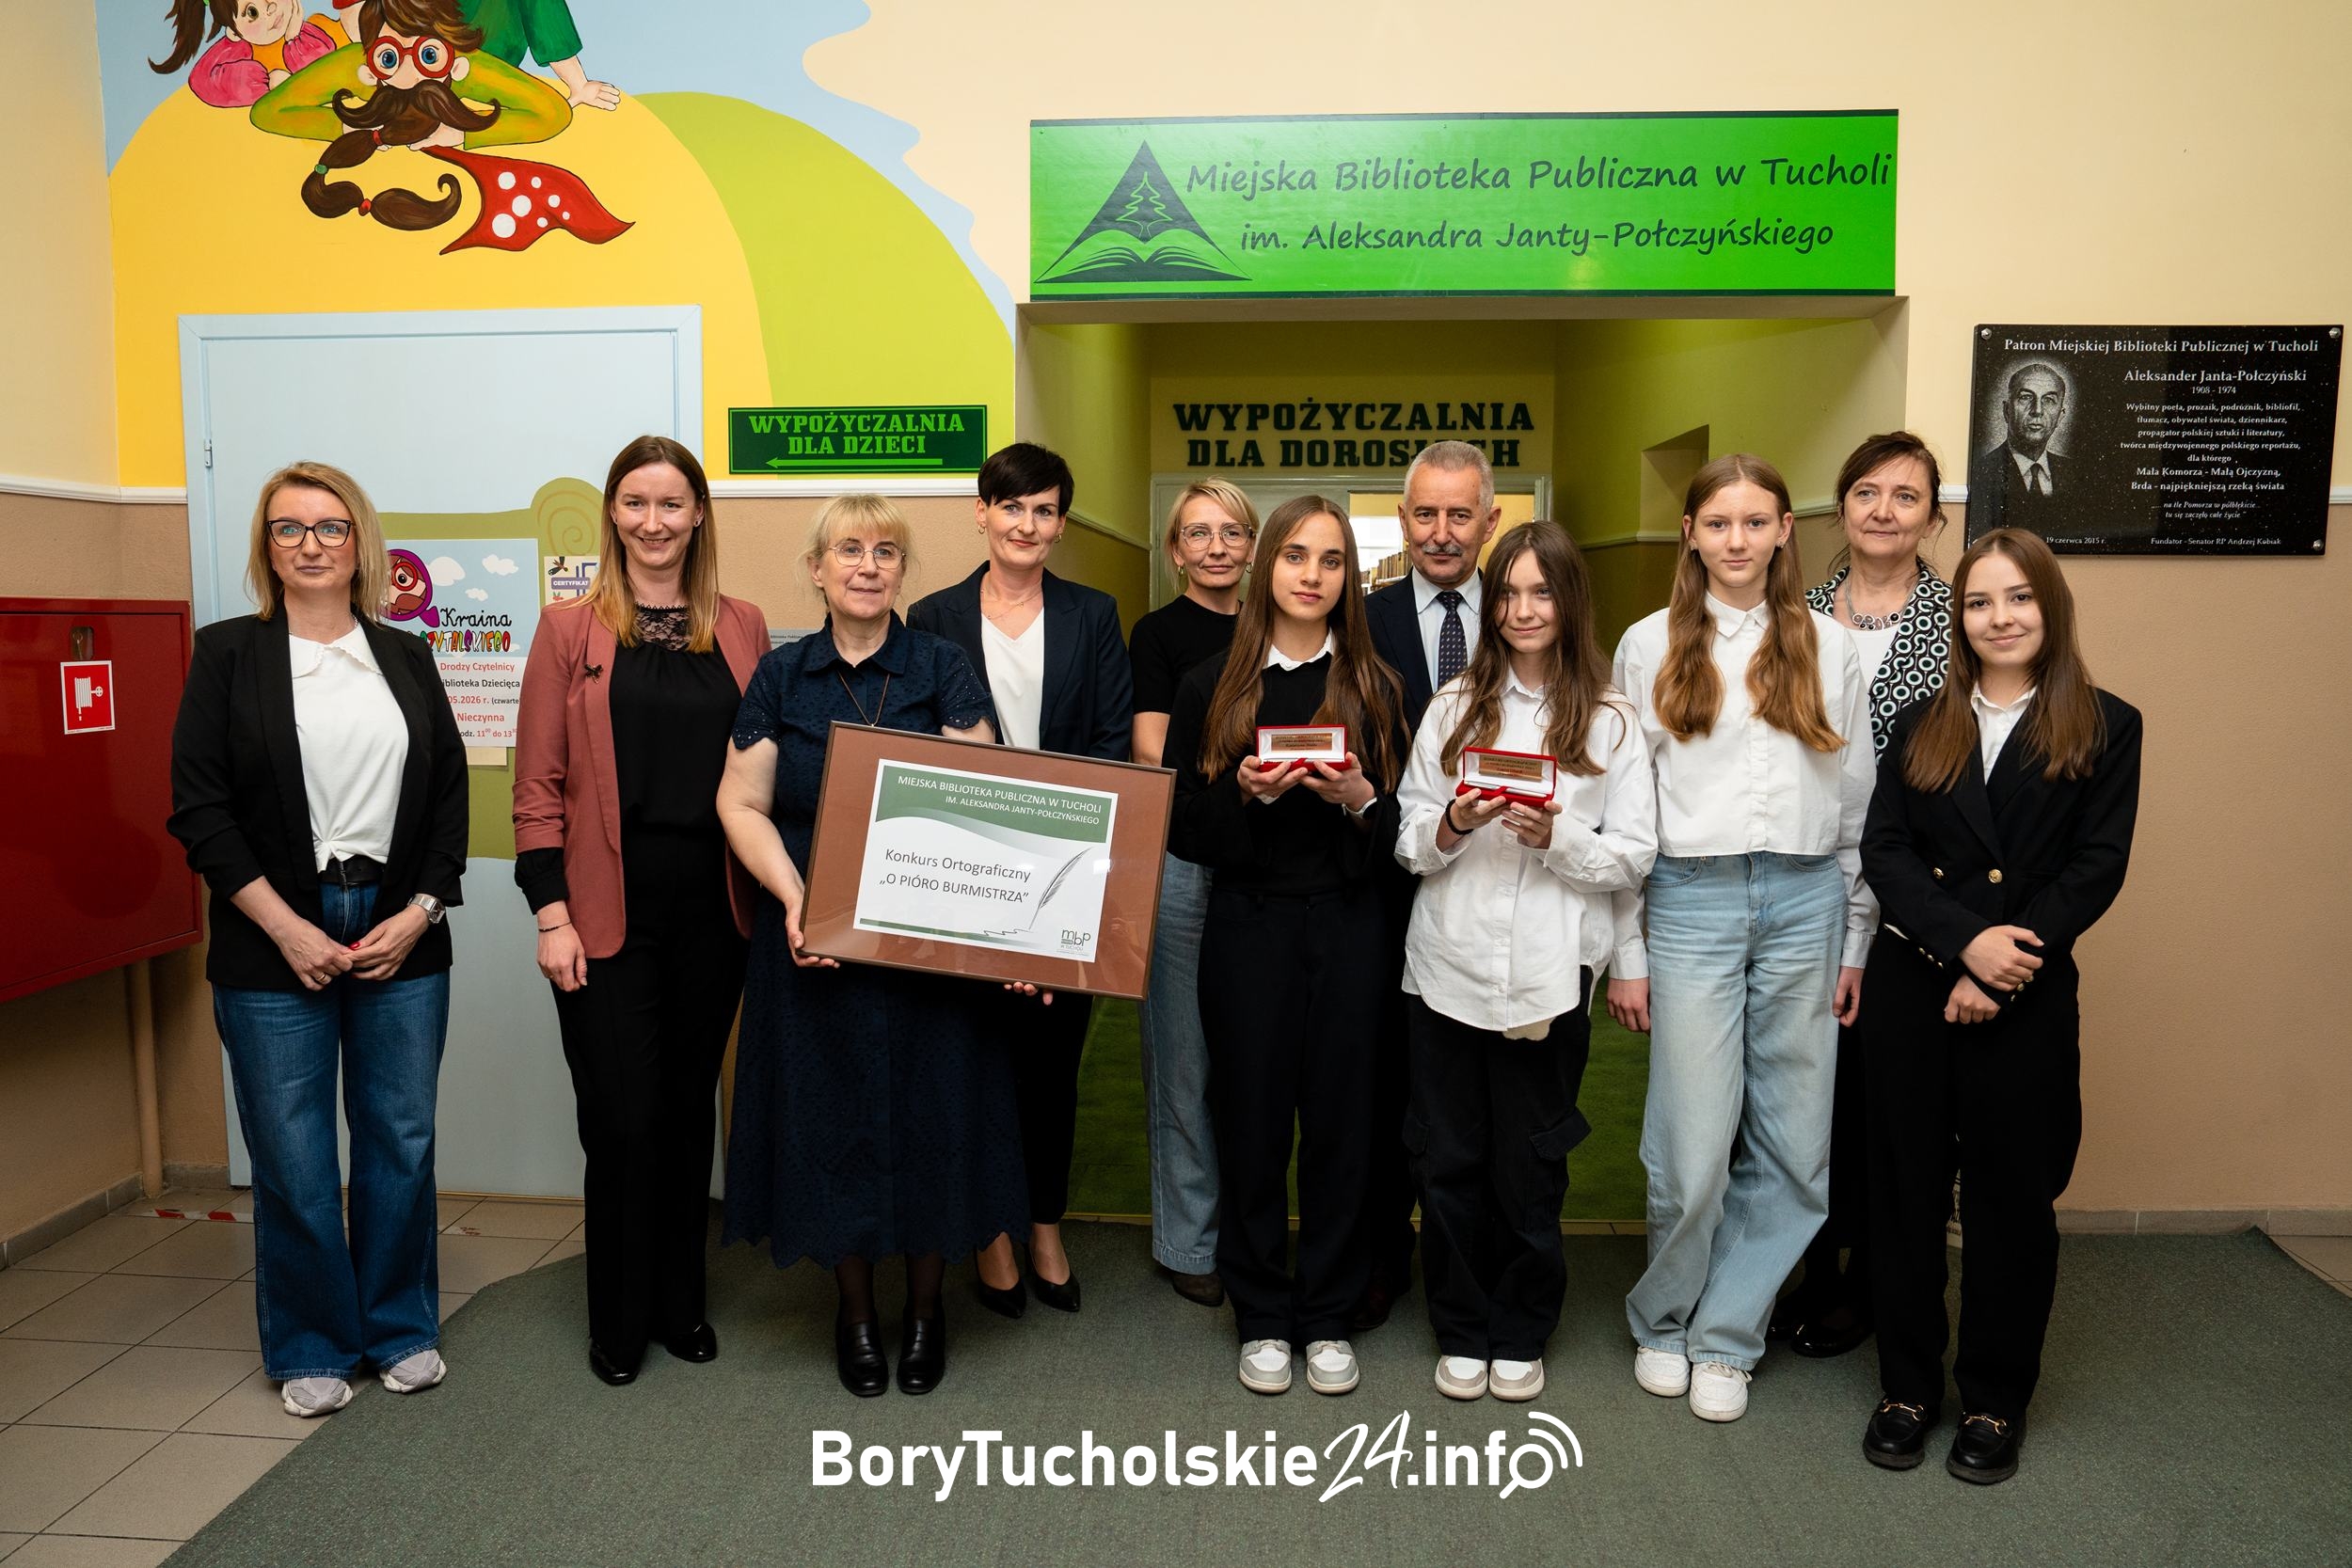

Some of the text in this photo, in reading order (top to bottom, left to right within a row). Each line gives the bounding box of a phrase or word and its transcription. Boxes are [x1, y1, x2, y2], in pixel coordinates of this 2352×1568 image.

[1186, 152, 1893, 201] Miejska Biblioteka Publiczna w Tucholi
[1241, 217, 1834, 257] im. Aleksandra Janty-Połczyńskiego
[2004, 339, 2318, 355] Patron Miejskiej Biblioteki Publicznej w Tucholi
[2123, 370, 2307, 384] Aleksander Janta-Połczyński
[2191, 386, 2211, 394] 1908
[2217, 386, 2236, 394] 1974
[1172, 396, 1534, 432] WYPOŻYCZALNIA
[2126, 403, 2301, 412] Wybitny poeta, prozaik, podróżnik, bibliofil,
[749, 412, 965, 434] WYPOŻYCZALNIA
[2171, 416, 2207, 425] obywatel
[2209, 416, 2236, 424] świata,
[2238, 416, 2288, 424] dziennikarz,
[2182, 429, 2213, 437] polskiej
[2246, 429, 2285, 437] literatury,
[787, 436, 926, 454] DLA DZIECI
[2148, 441, 2219, 451] międzywojennego
[2220, 441, 2259, 451] polskiego
[2261, 441, 2301, 451] reportażu,
[1186, 439, 1520, 468] DLA DOROSH
[2201, 454, 2232, 464] którego
[2137, 467, 2159, 476] Mała
[2162, 467, 2203, 476] Komorza
[2211, 467, 2234, 478] Małą
[2235, 467, 2281, 478] Ojczyzną,
[2131, 482, 2153, 490] Brda
[2160, 482, 2227, 492] najpiękniejszą
[2228, 482, 2253, 492] rzeką
[2255, 481, 2284, 490] świata
[2227, 537, 2255, 546] Andrzej
[440, 607, 513, 627] Kraina
[440, 662, 515, 673] Drodzy Czytelnicy
[442, 678, 520, 689] iblioteka Dziecięca
[447, 696, 482, 705] 05.2026
[491, 697, 520, 705] (czwarte
[456, 713, 505, 723] Nieczynna
[898, 775, 1102, 815] MIEJSKA BIBLIOTEKA PUBLICZNA W TUCHOLI
[946, 796, 1100, 825] IM. ALEKSANDRA JANTY-POŁCZYŃSKIEGO
[885, 848, 1031, 883] Konkurs Ortograficzny
[899, 874, 939, 891] PIÓRO
[943, 880, 1029, 903] BURMISTRZA”
[1061, 929, 1091, 946] mbp
